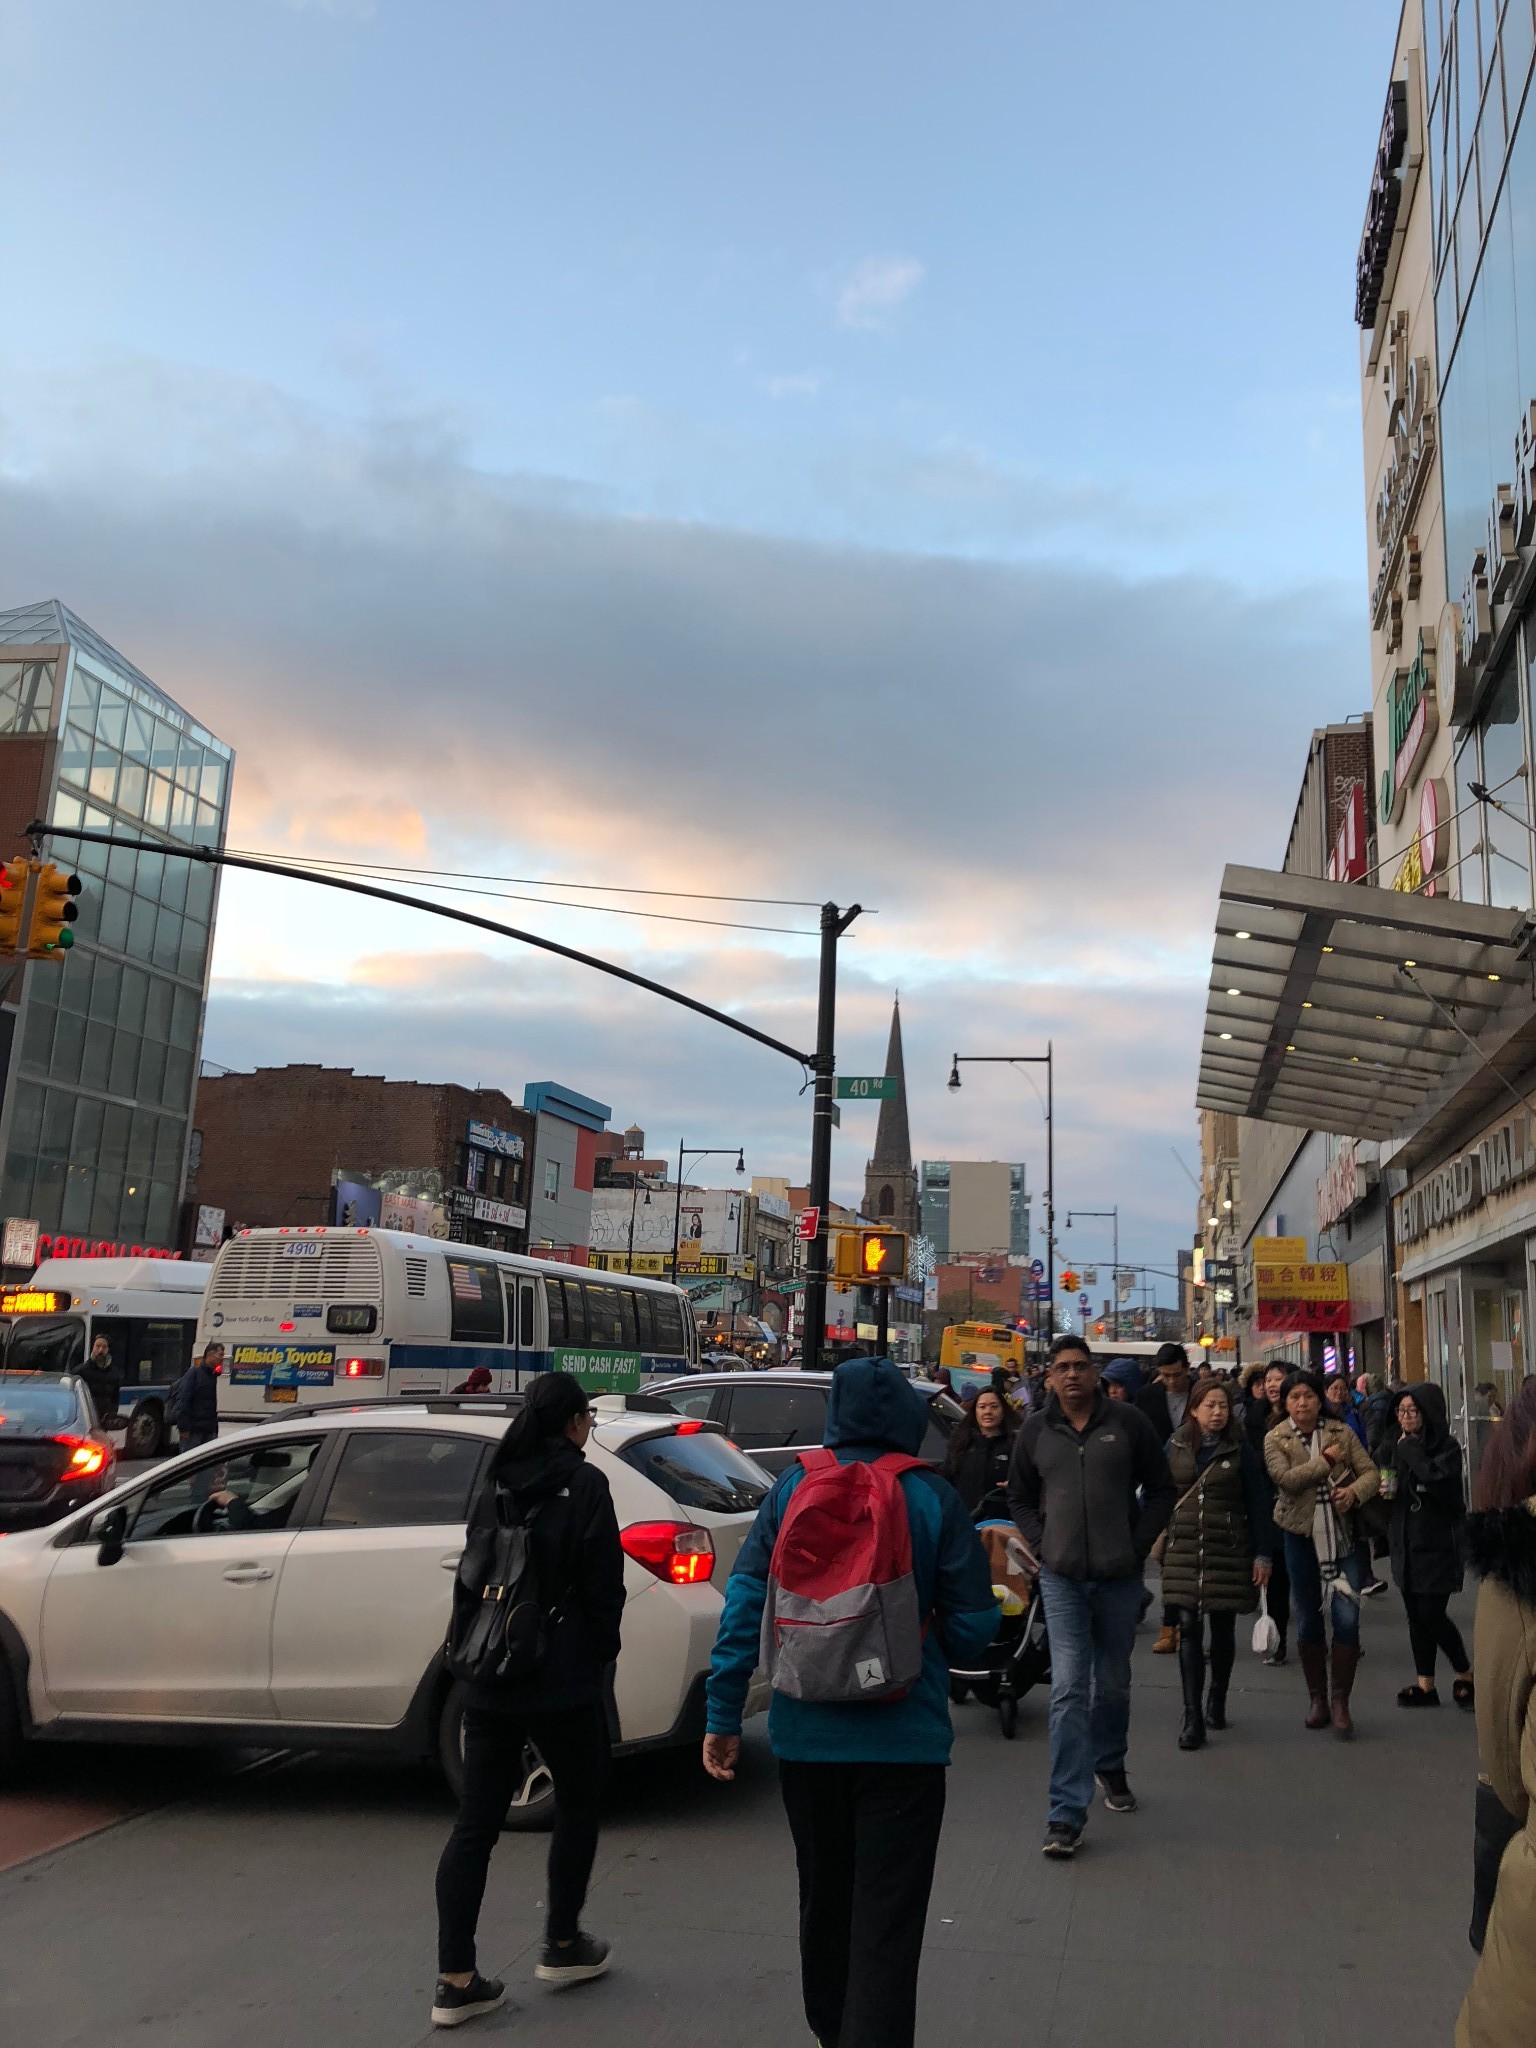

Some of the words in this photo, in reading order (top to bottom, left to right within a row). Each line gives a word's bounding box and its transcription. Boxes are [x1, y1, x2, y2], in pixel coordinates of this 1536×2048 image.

[1381, 625, 1428, 825] Jmart
[849, 1079, 869, 1096] 40
[873, 1078, 883, 1089] Rd
[1393, 1188, 1419, 1244] NEW
[1420, 1155, 1473, 1230] WORLD
[1479, 1108, 1536, 1197] MALL
[286, 1243, 316, 1255] 4910
[251, 1316, 262, 1324] City
[263, 1315, 275, 1323] Bus
[234, 1347, 284, 1364] Hillside
[285, 1347, 333, 1368] Toyota
[562, 1354, 587, 1373] SEND
[589, 1356, 611, 1373] CASH
[612, 1357, 636, 1374] FAST!
